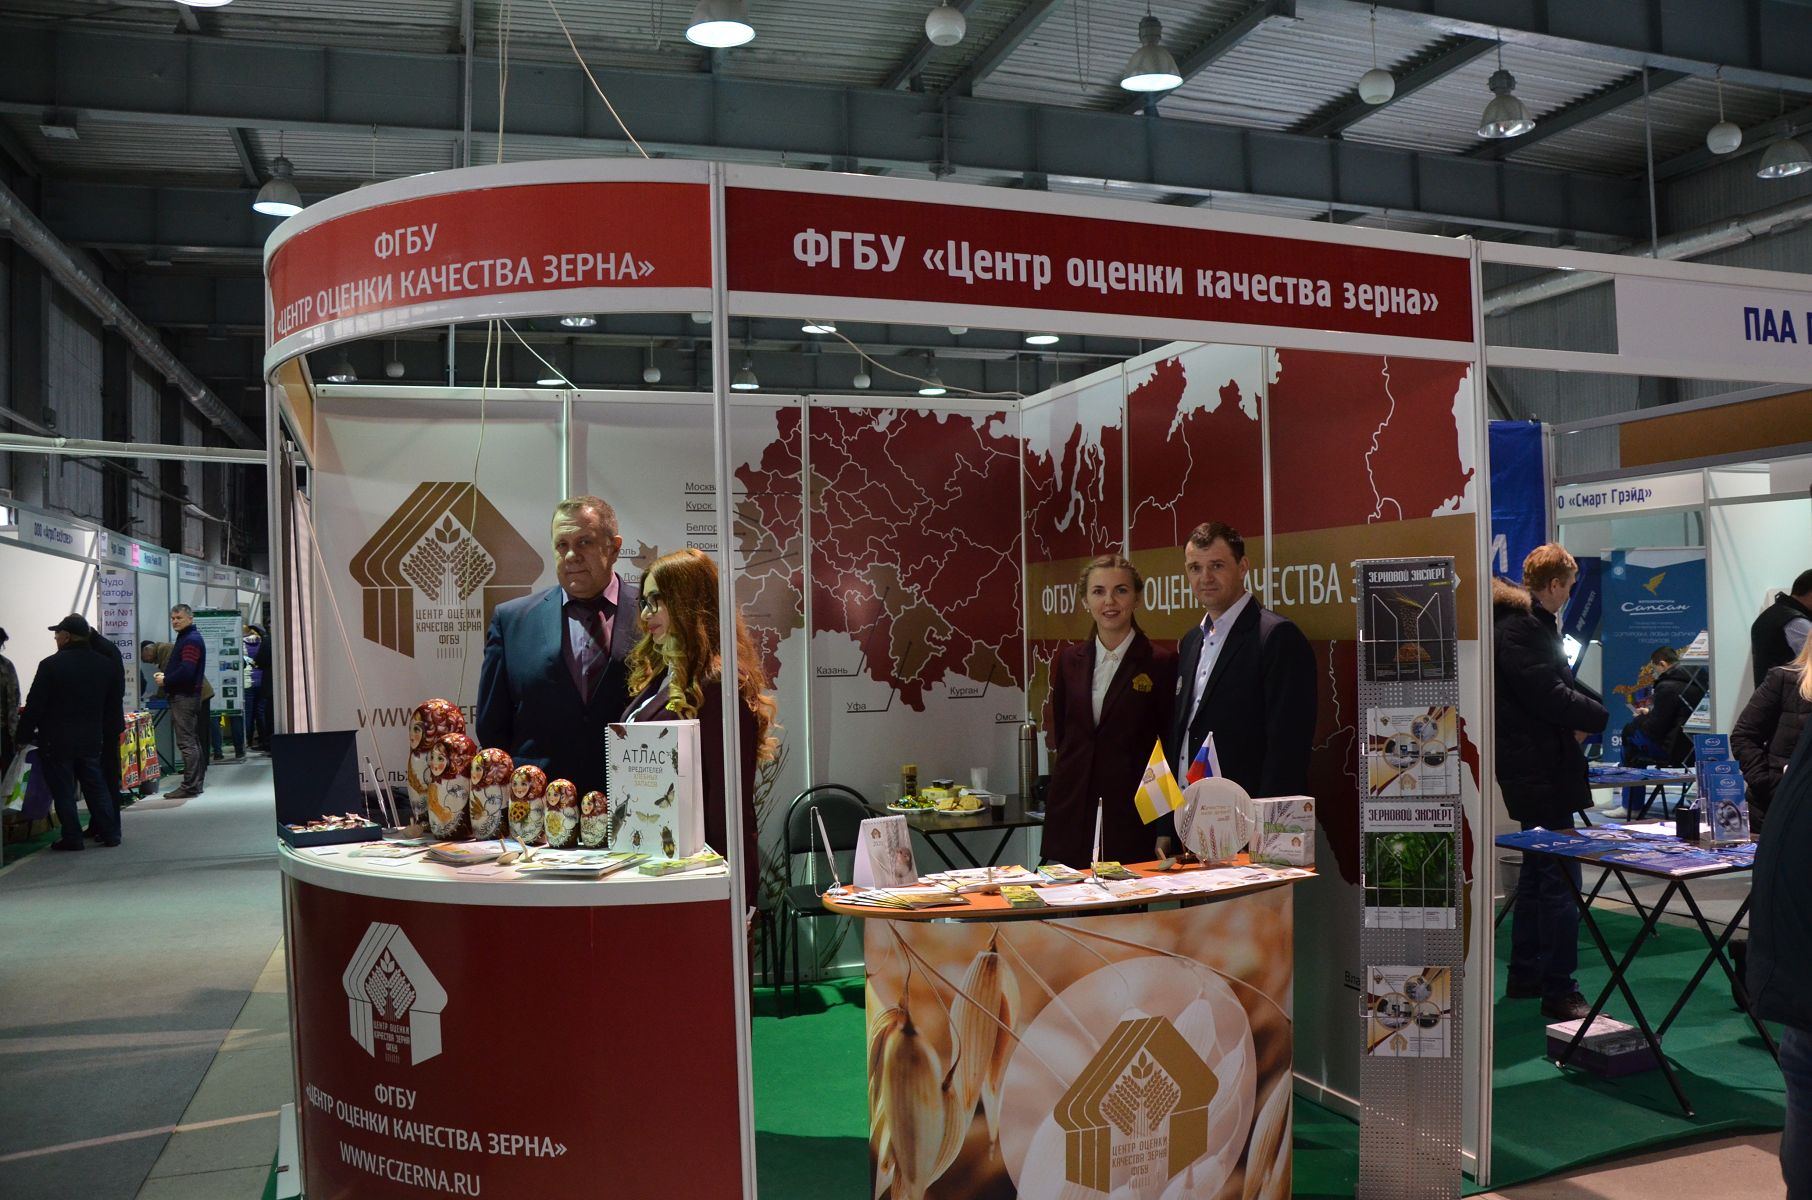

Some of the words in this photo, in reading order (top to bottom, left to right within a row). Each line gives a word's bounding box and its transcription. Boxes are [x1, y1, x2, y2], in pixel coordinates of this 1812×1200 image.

[374, 223, 438, 260] ФГБУ
[793, 228, 906, 273] ФГБУ
[923, 239, 1051, 292] «Центр
[1067, 258, 1183, 297] оценки
[1197, 267, 1331, 308] качества
[1343, 280, 1439, 318] зерна»
[277, 296, 312, 336] «ЦЕНТР
[316, 273, 393, 319] ОЦЕНКИ
[400, 256, 534, 298] КАЧЕСТВА
[542, 252, 655, 285] ЗЕРНА»
[1744, 306, 1797, 344] ПАА
[1569, 493, 1607, 508] «Смарт
[1611, 487, 1652, 505] Грэйд»
[686, 501, 712, 510] Курск
[1368, 569, 1409, 583] ЗЕРНОВОЙ
[1412, 567, 1446, 582] ЭКСПЕРТ
[1042, 584, 1077, 616] ФГБУ
[1144, 575, 1200, 615] ОЦЕН
[416, 609, 443, 620] ЦЕНТР
[448, 608, 481, 620] ОЦЕНКИ
[1621, 601, 1691, 613] Сапсан
[416, 622, 453, 632] КАЧЕСТВА
[458, 622, 482, 631] ЗЕРНА
[439, 634, 459, 645] ФГБУ
[817, 666, 848, 675] Казань
[950, 687, 978, 696] Курган
[847, 702, 866, 711] Уфа
[995, 713, 1017, 721] Омск
[622, 749, 666, 764] АТЛАС
[1368, 807, 1412, 821] ЗЕРНОВОЙ
[1415, 808, 1452, 821] ЭКСПЕРТ
[373, 1020, 388, 1031] ЦЕНТР
[390, 1023, 410, 1035] ОЦЕНКИ
[374, 1083, 417, 1110] ФГБУ
[305, 1082, 334, 1114] «ЦЕНТР
[336, 1100, 389, 1137] ОЦЕНКИ
[393, 1117, 483, 1153] КАЧЕСТВА
[488, 1132, 568, 1158] ЗЕРНА»
[1112, 1142, 1136, 1156] ЦЕНТР
[1139, 1136, 1168, 1151] ОЦЕНКИ
[1112, 1153, 1145, 1168] КАЧЕСТВА
[1147, 1148, 1168, 1161] ЗЕРНА
[339, 1140, 481, 1197] WWW.FCZERNA.RU
[1130, 1164, 1149, 1176] ФГБУ
